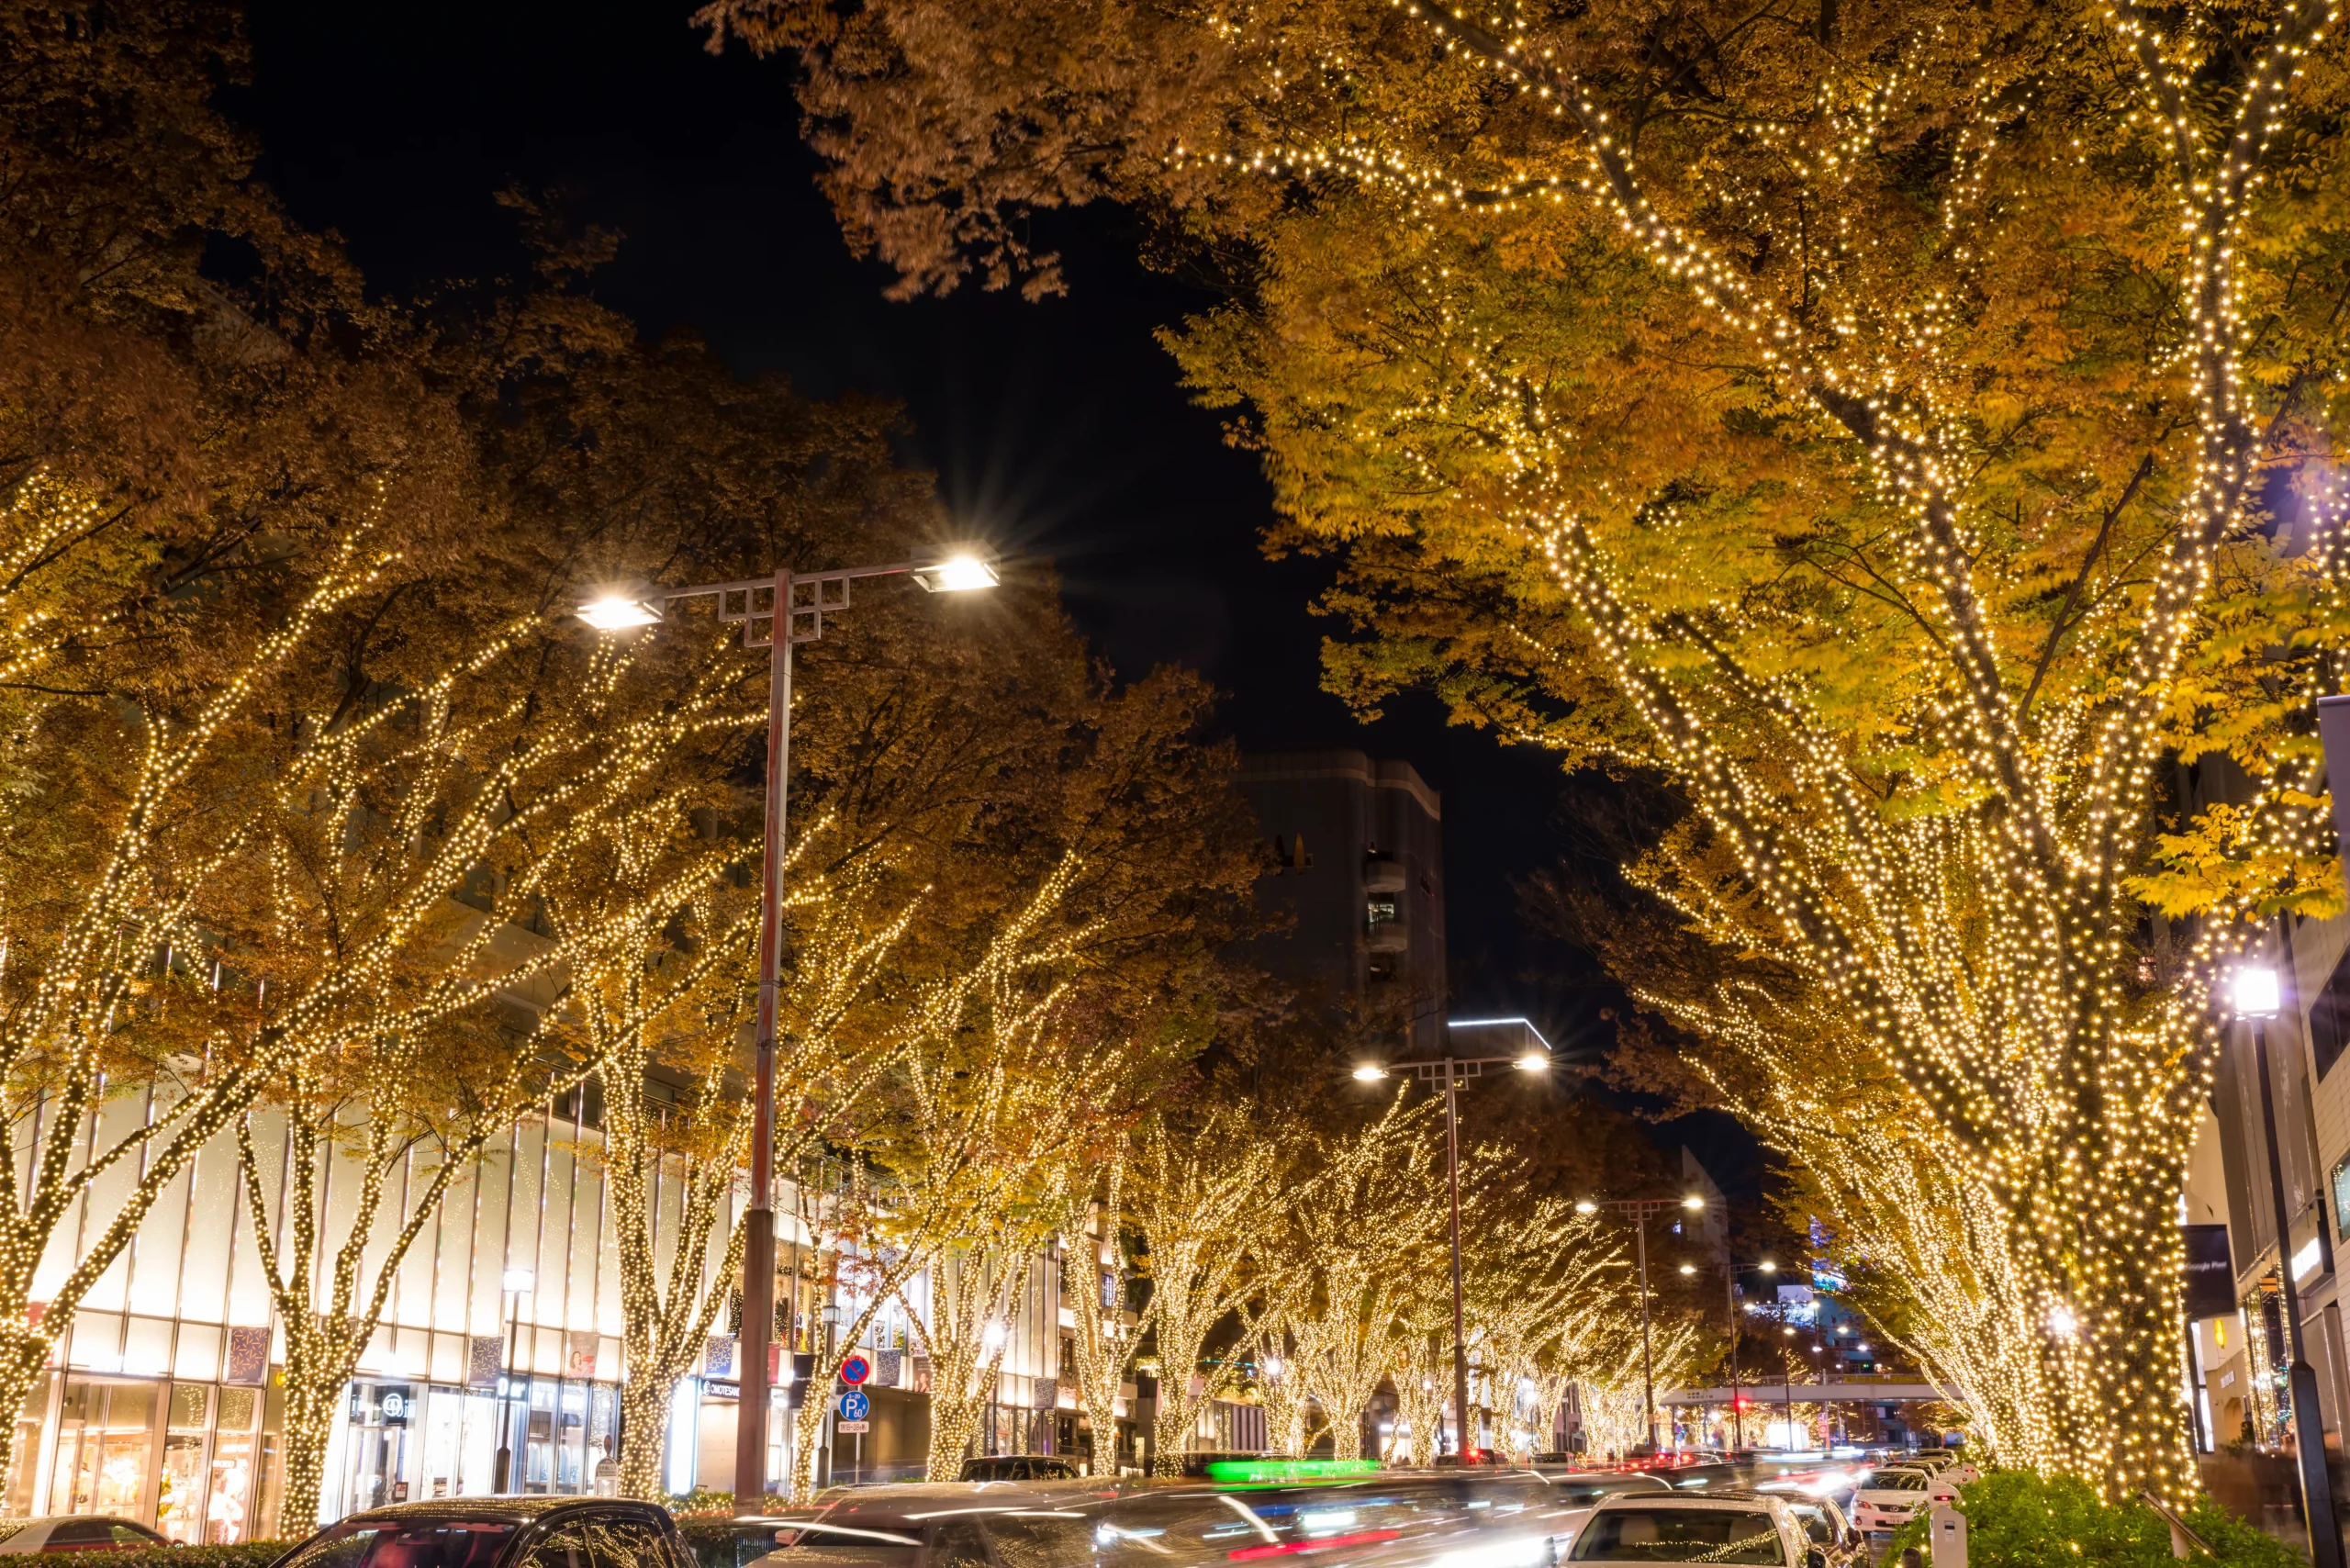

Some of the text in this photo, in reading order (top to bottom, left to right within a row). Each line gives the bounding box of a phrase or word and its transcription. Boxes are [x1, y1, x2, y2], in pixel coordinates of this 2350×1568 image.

[2187, 1261, 2210, 1271] Google
[711, 1383, 740, 1396] OMOTESAN
[845, 1398, 858, 1417] P
